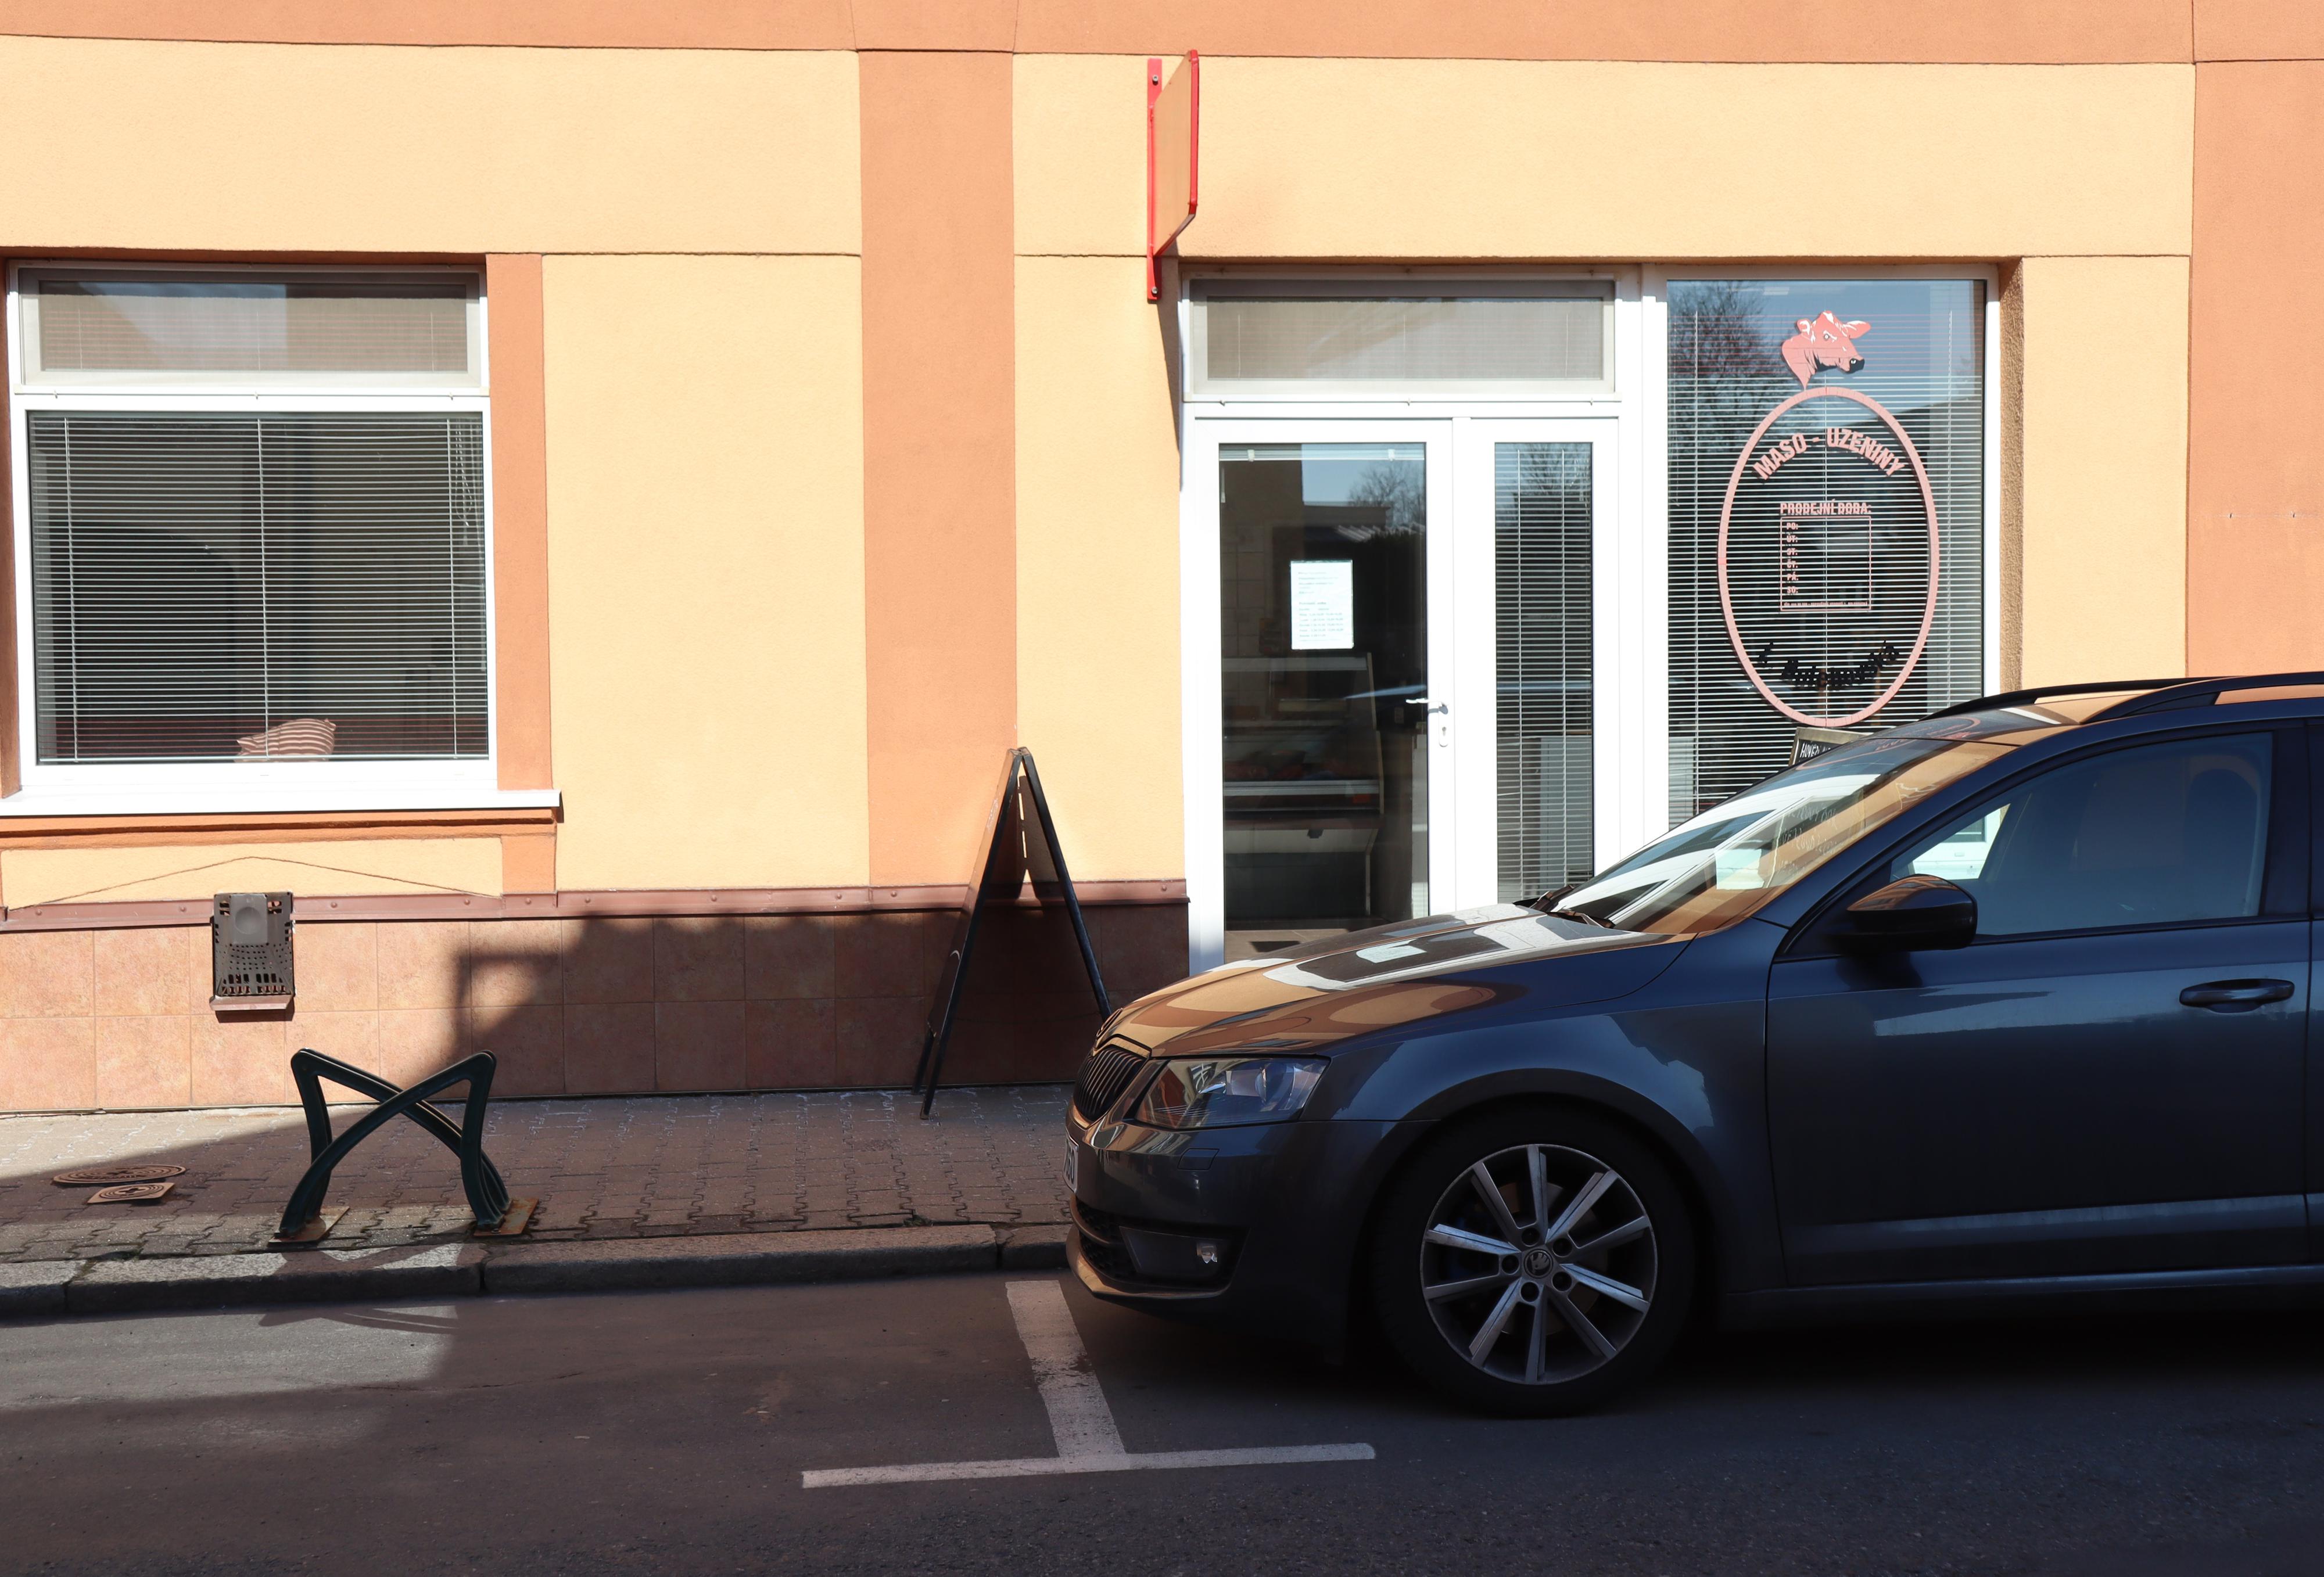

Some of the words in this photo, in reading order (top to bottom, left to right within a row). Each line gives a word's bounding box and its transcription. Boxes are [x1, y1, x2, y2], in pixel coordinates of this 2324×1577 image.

[1752, 433, 1807, 481] MASO
[1826, 428, 1905, 476] UZENINY
[1780, 498, 1837, 515] PRODEJNÍ
